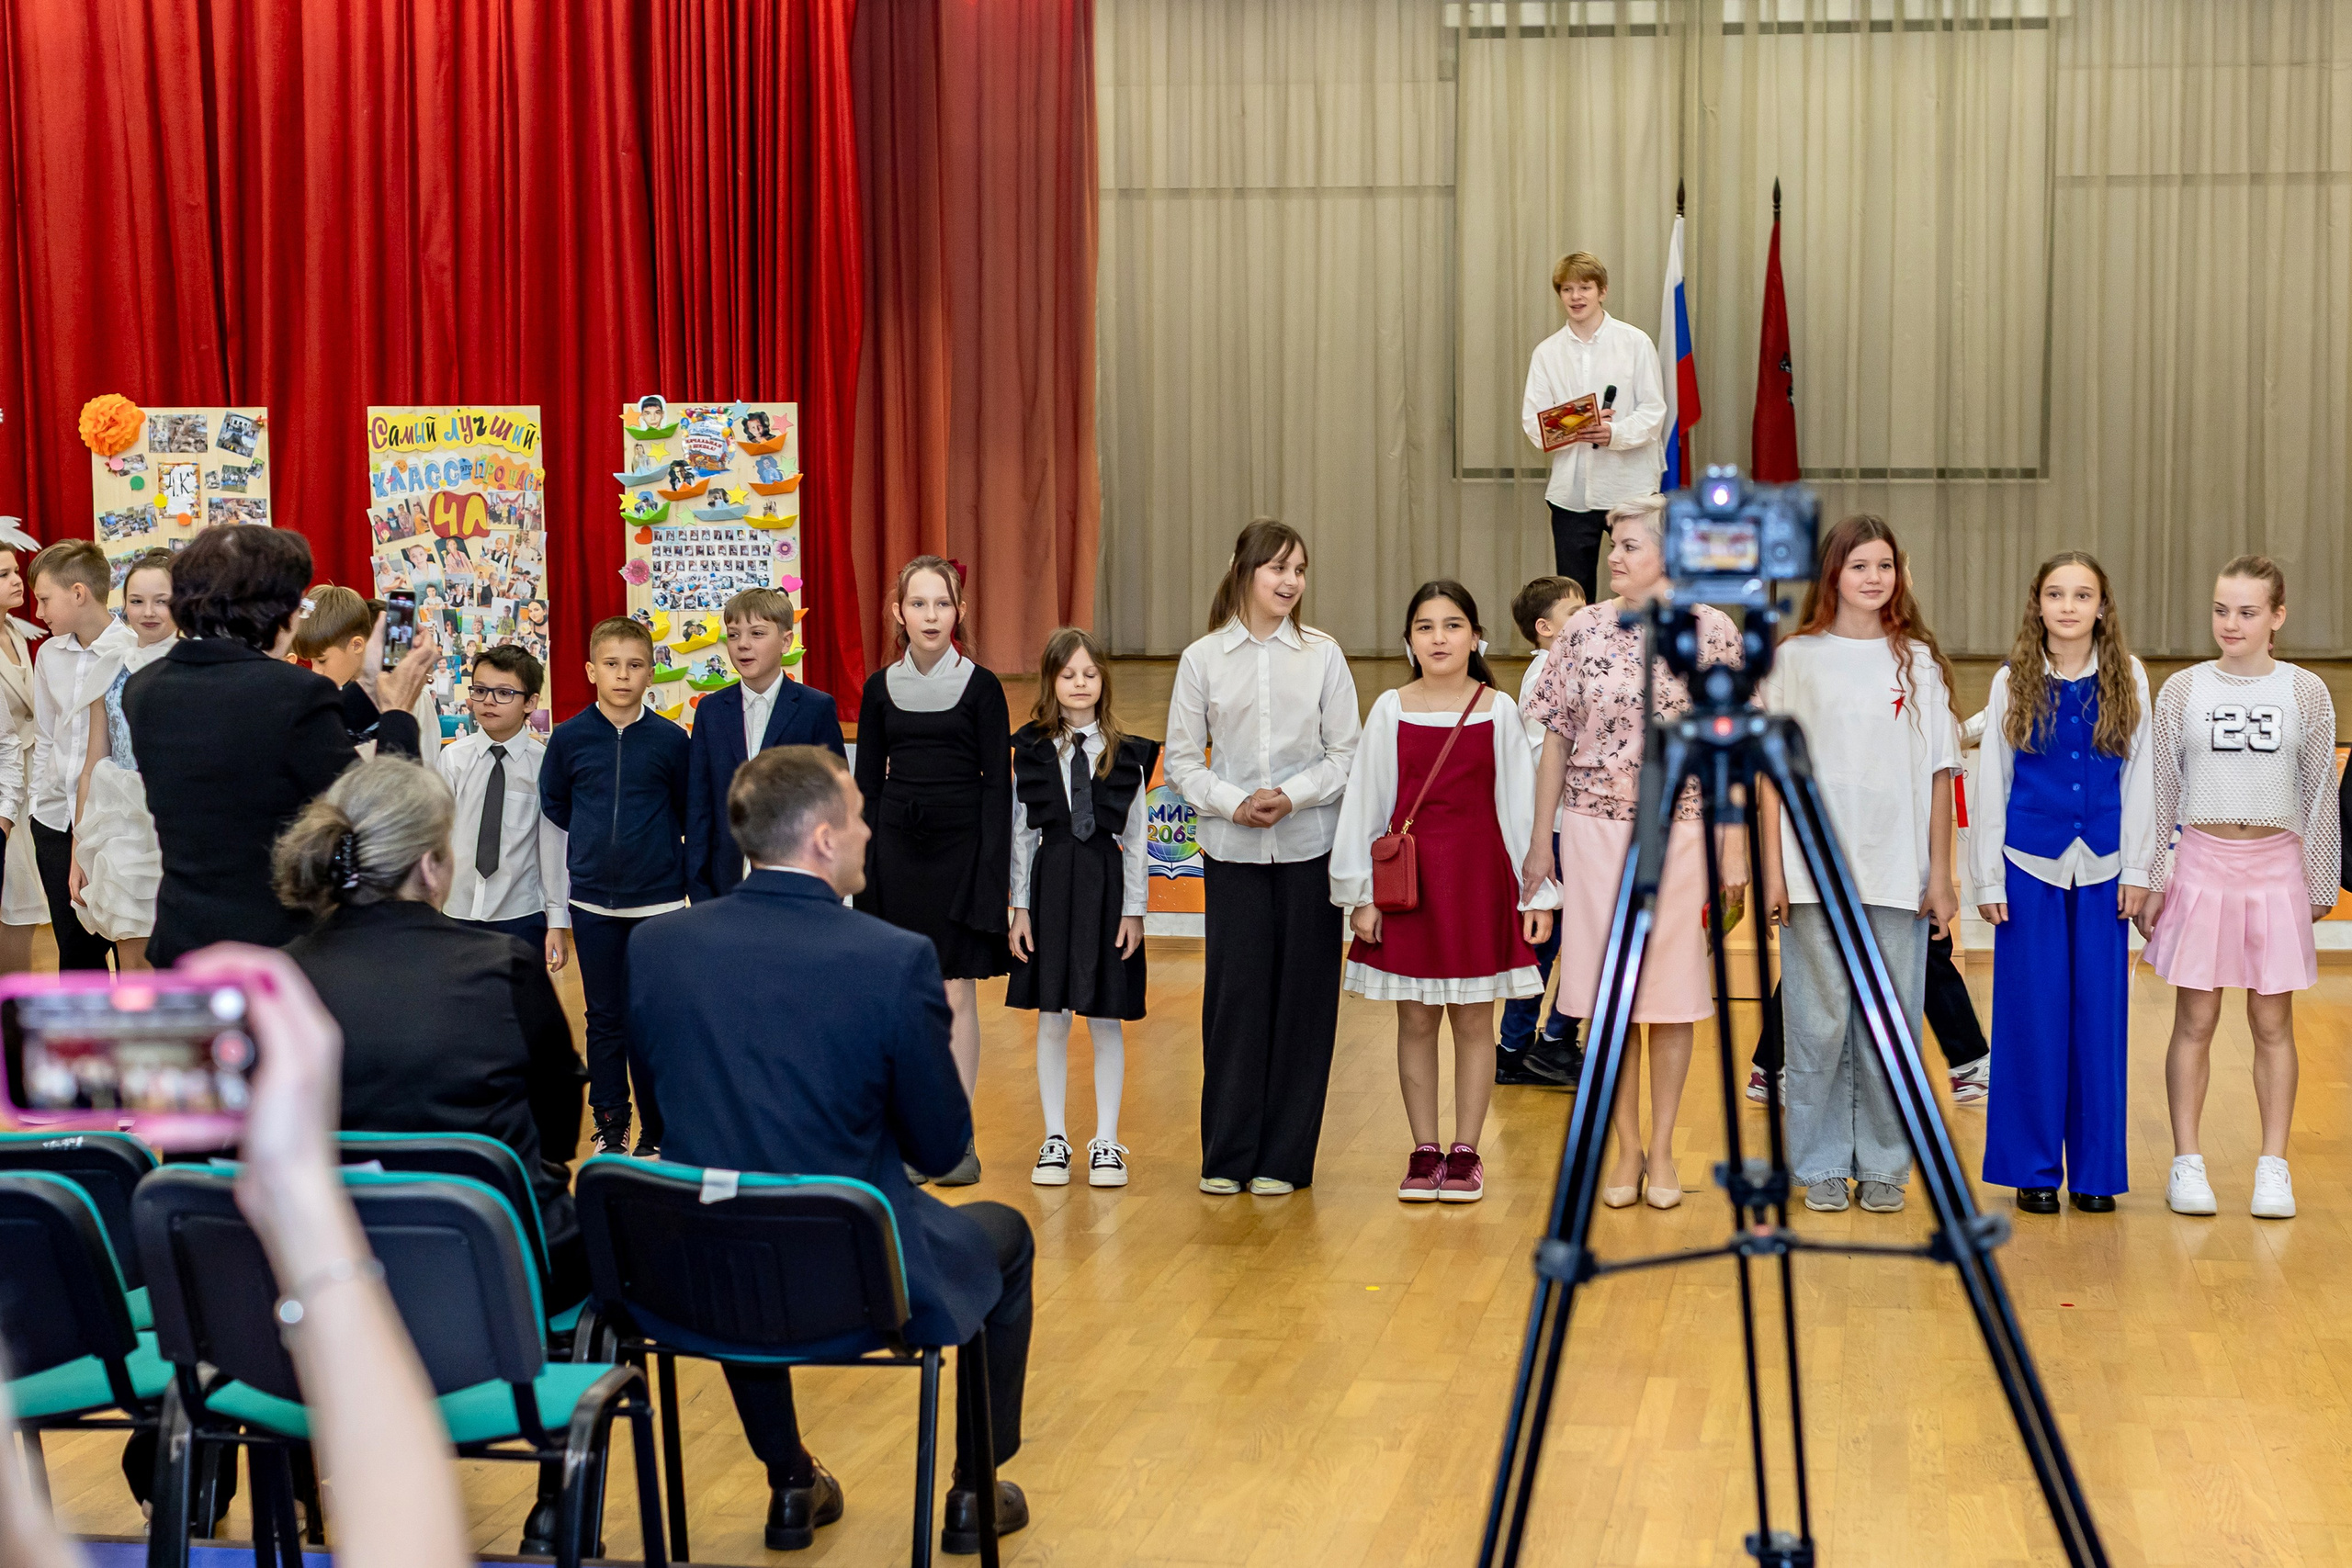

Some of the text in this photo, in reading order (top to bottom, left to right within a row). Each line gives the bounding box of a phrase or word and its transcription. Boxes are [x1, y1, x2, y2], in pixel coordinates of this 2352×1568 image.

[372, 416, 436, 449] Самый
[373, 459, 460, 498] КЛАСС
[474, 459, 505, 484] ПРО
[2211, 704, 2284, 753] 23
[1148, 804, 1197, 824] МИР
[1148, 824, 1196, 844] 2065
